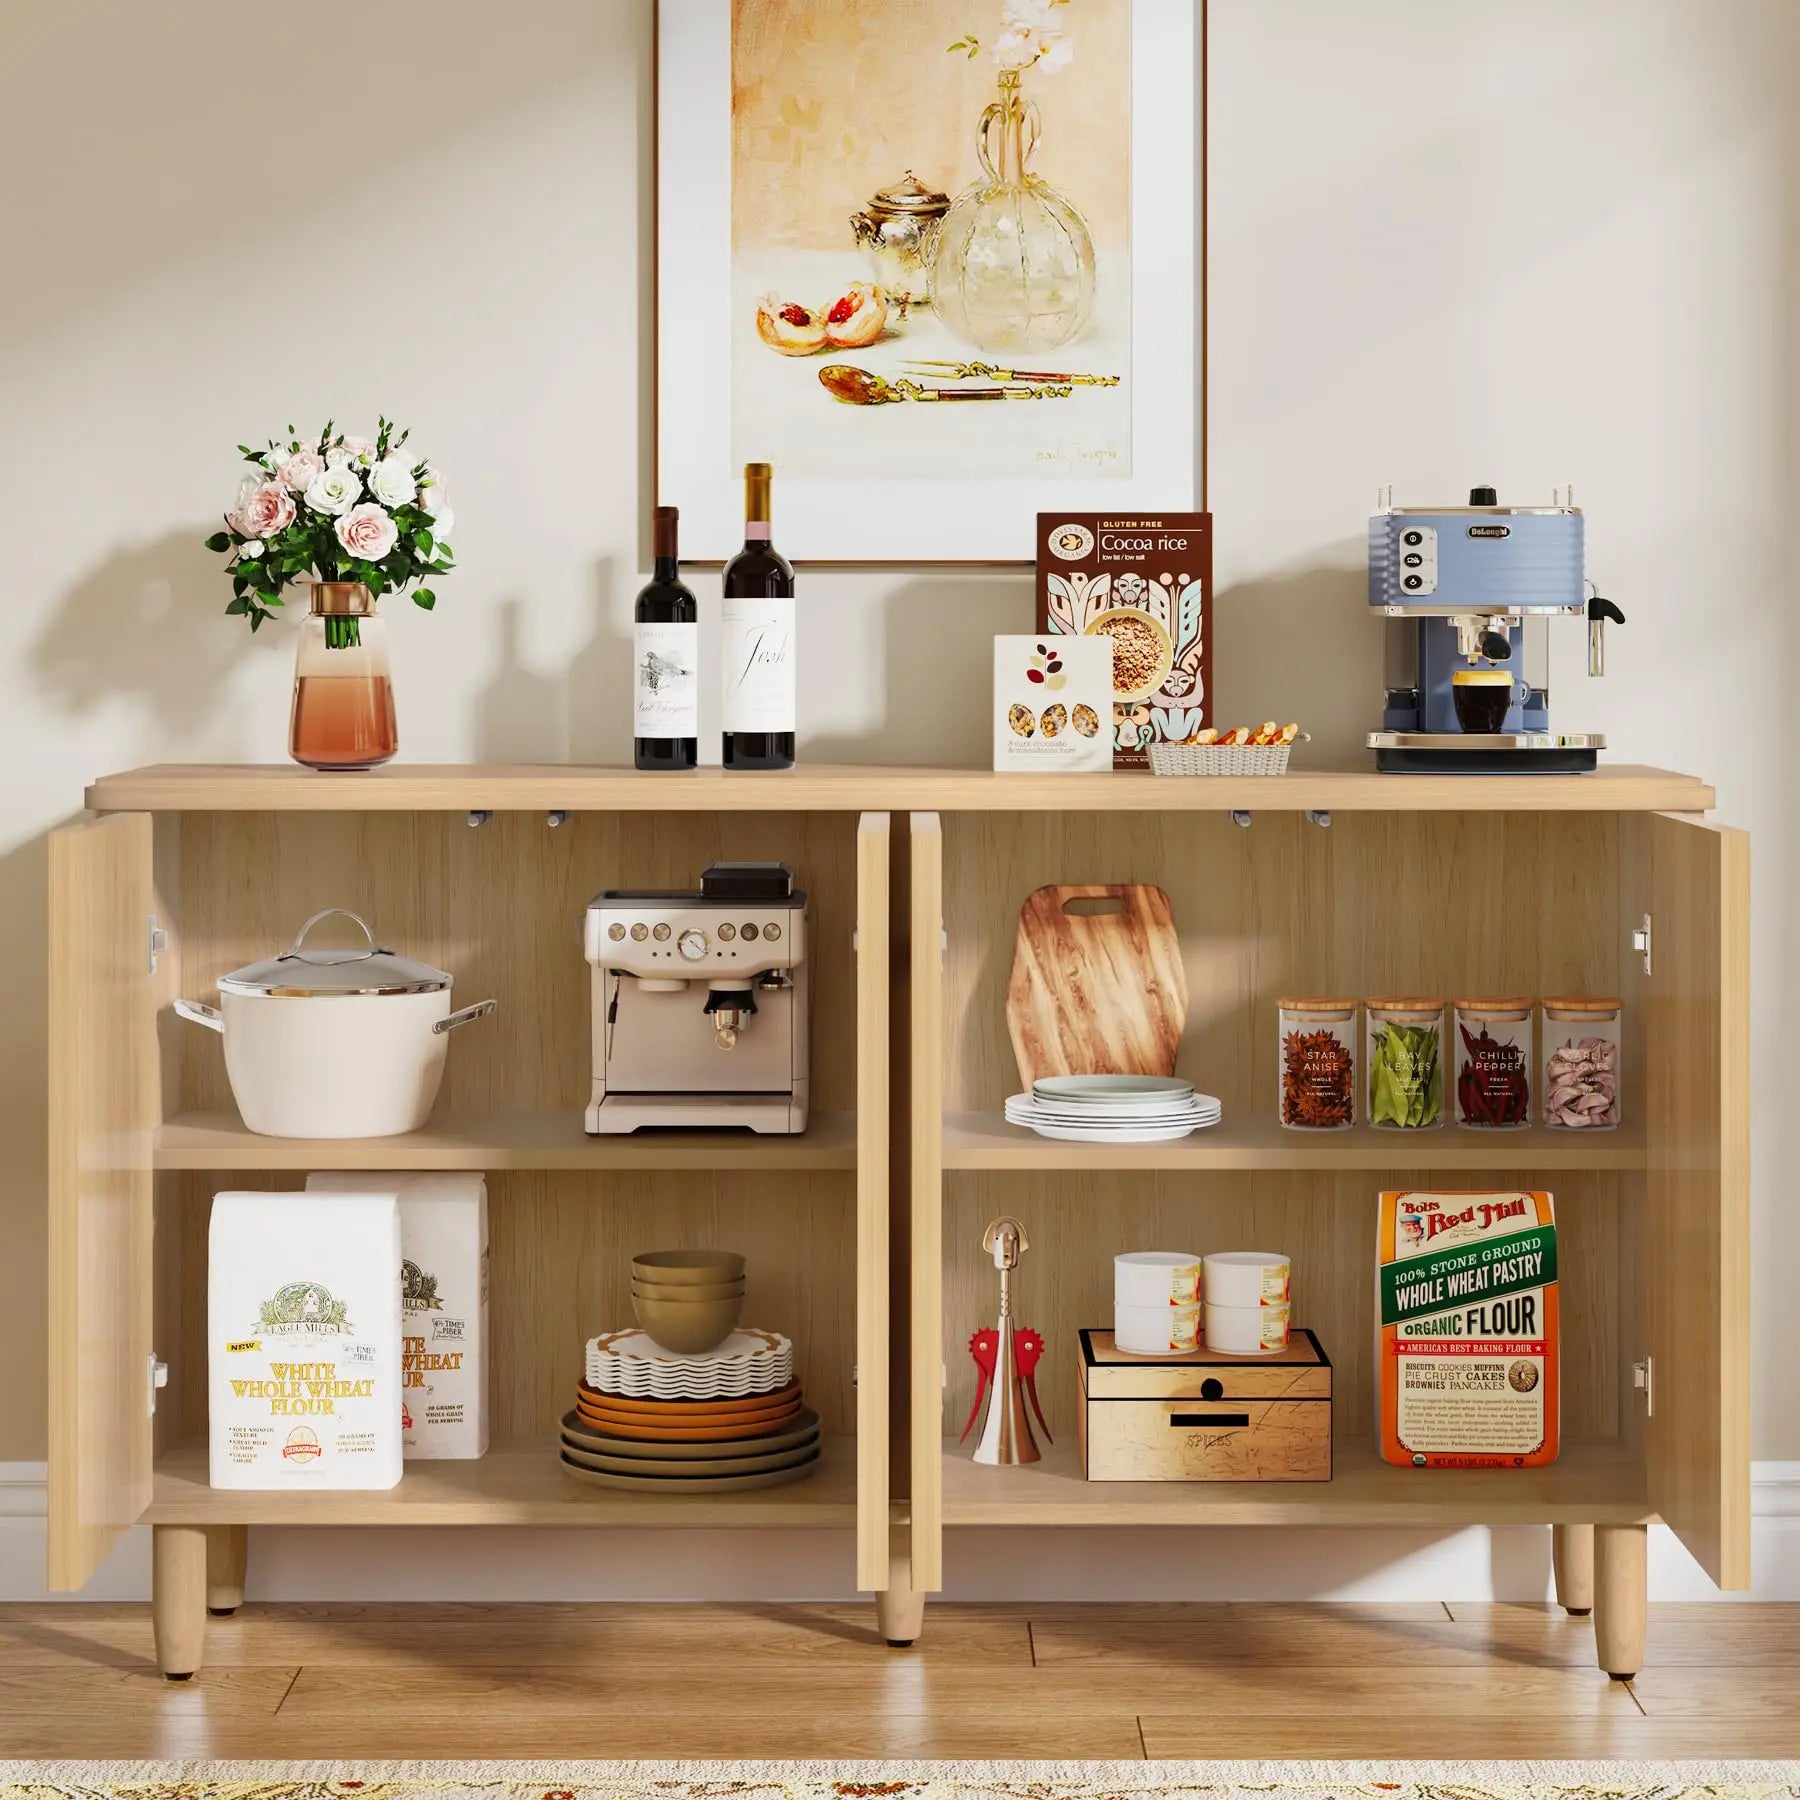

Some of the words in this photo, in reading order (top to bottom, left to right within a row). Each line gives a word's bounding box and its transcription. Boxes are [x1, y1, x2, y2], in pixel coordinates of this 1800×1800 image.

[1101, 535, 1153, 551] Cocoa
[1158, 535, 1188, 551] rice
[1307, 1051, 1336, 1060] STAR
[1399, 1051, 1421, 1060] BAY
[1479, 1051, 1517, 1060] CHILLI
[1303, 1063, 1339, 1071] ANISE
[1388, 1062, 1431, 1071] LEAVES
[1475, 1062, 1521, 1071] PEPPER
[1401, 1201, 1440, 1214] Bob's
[1426, 1206, 1476, 1241] Red
[1477, 1198, 1527, 1230] Mill
[1394, 1268, 1425, 1285] 100%
[1430, 1253, 1477, 1275] STONE
[1482, 1237, 1541, 1261] GROUND
[1396, 1278, 1444, 1311] WHOLE
[1447, 1266, 1490, 1298] WHEAT
[1493, 1251, 1543, 1286] PASTRY
[1404, 1314, 1462, 1336] ORGANIC
[1466, 1295, 1536, 1336] FLOUR
[444, 1320, 465, 1328] TIMES
[442, 1327, 462, 1336] FIBER
[230, 1342, 255, 1352] NEW
[1406, 1343, 1448, 1353] AMERICA'S
[1450, 1344, 1471, 1353] BEST
[1473, 1344, 1504, 1353] BAKING
[1506, 1344, 1532, 1353] FLOUR
[402, 1353, 464, 1370] WHEAT
[270, 1363, 336, 1381] WHITE
[1405, 1363, 1436, 1371] BISCUITS
[1438, 1363, 1472, 1371] COOKIES
[1474, 1363, 1505, 1371] MUFFINS
[1405, 1372, 1421, 1380] PIE
[1424, 1372, 1462, 1380] CRUST
[1466, 1372, 1505, 1381] CAKES
[230, 1380, 301, 1398] WHOLE
[303, 1379, 375, 1397] WHEAT
[1405, 1381, 1446, 1390] BROWNIES
[1449, 1381, 1505, 1390] PANCAKES
[271, 1399, 335, 1416] FLOUR
[1186, 1434, 1231, 1447] SPICES
